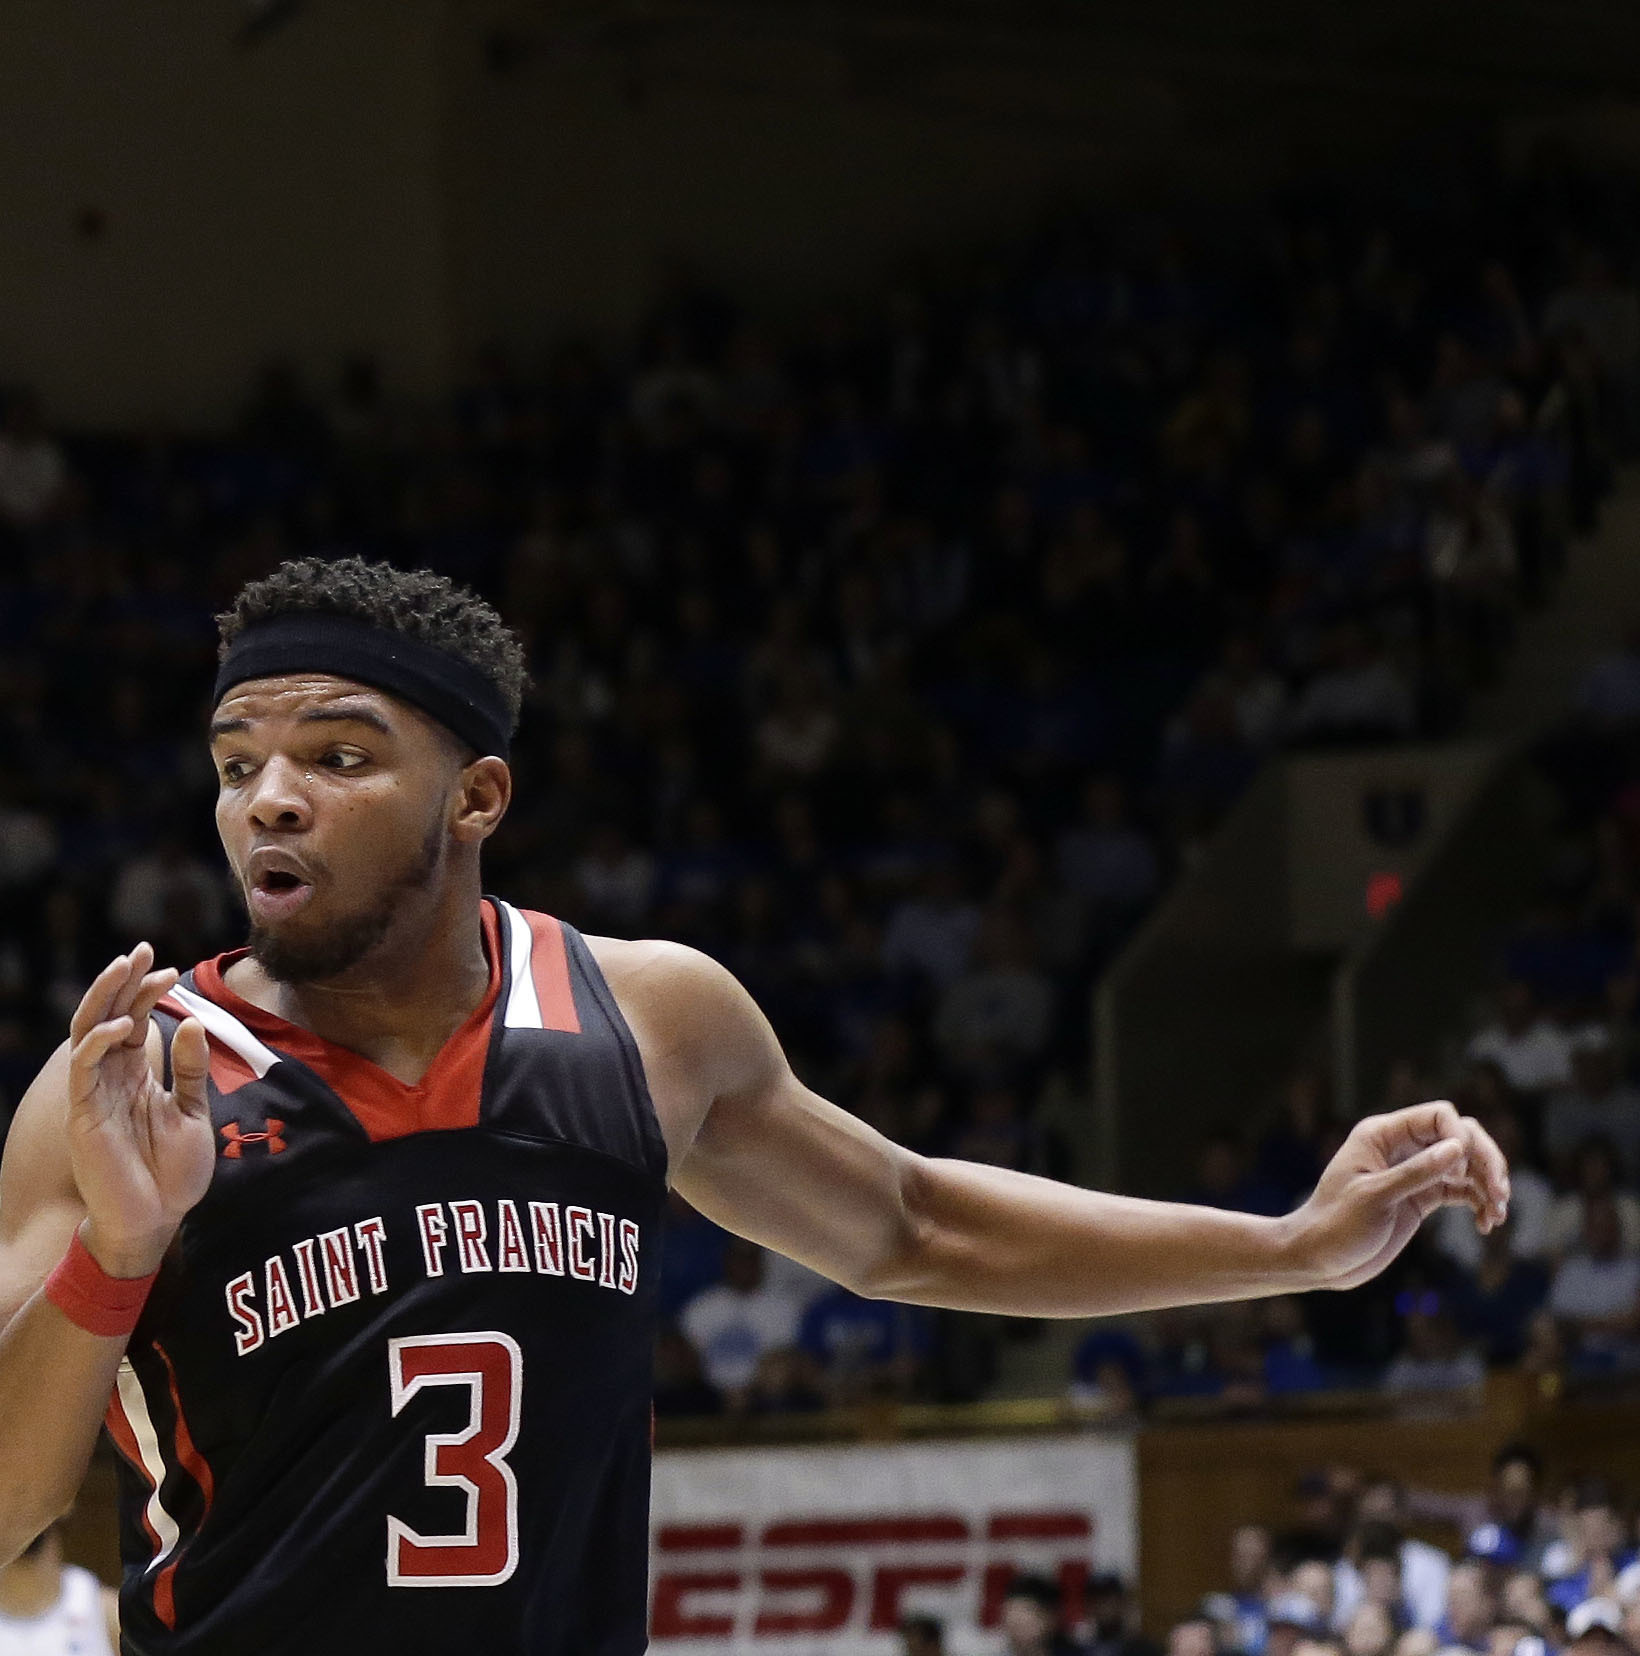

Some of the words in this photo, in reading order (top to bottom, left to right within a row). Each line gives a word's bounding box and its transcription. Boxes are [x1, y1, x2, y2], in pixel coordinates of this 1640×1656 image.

[225, 1216, 388, 1357] SAINT
[415, 1199, 640, 1296] FRANCIS
[385, 1330, 524, 1587] 3
[650, 1510, 1093, 1639] ESPN
